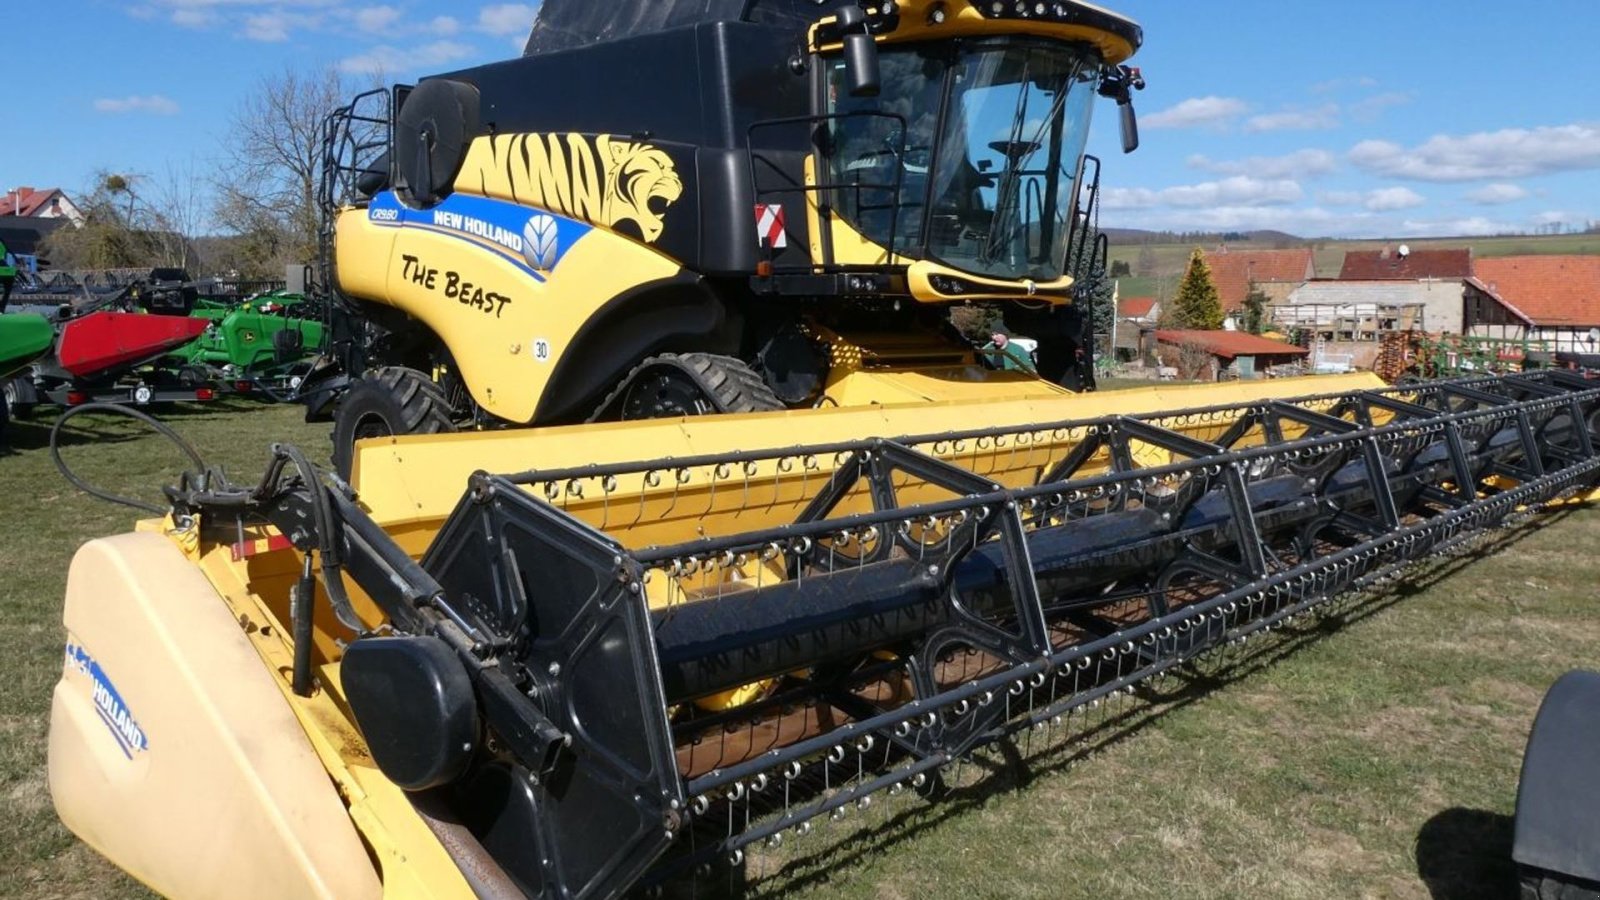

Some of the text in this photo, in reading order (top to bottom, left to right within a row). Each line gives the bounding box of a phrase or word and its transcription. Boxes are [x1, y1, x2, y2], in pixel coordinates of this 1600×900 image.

[434, 210, 522, 252] NEW HOLLAND
[402, 254, 511, 318] THE BEAST
[536, 342, 547, 358] 30
[93, 678, 142, 750] HOLLAND
